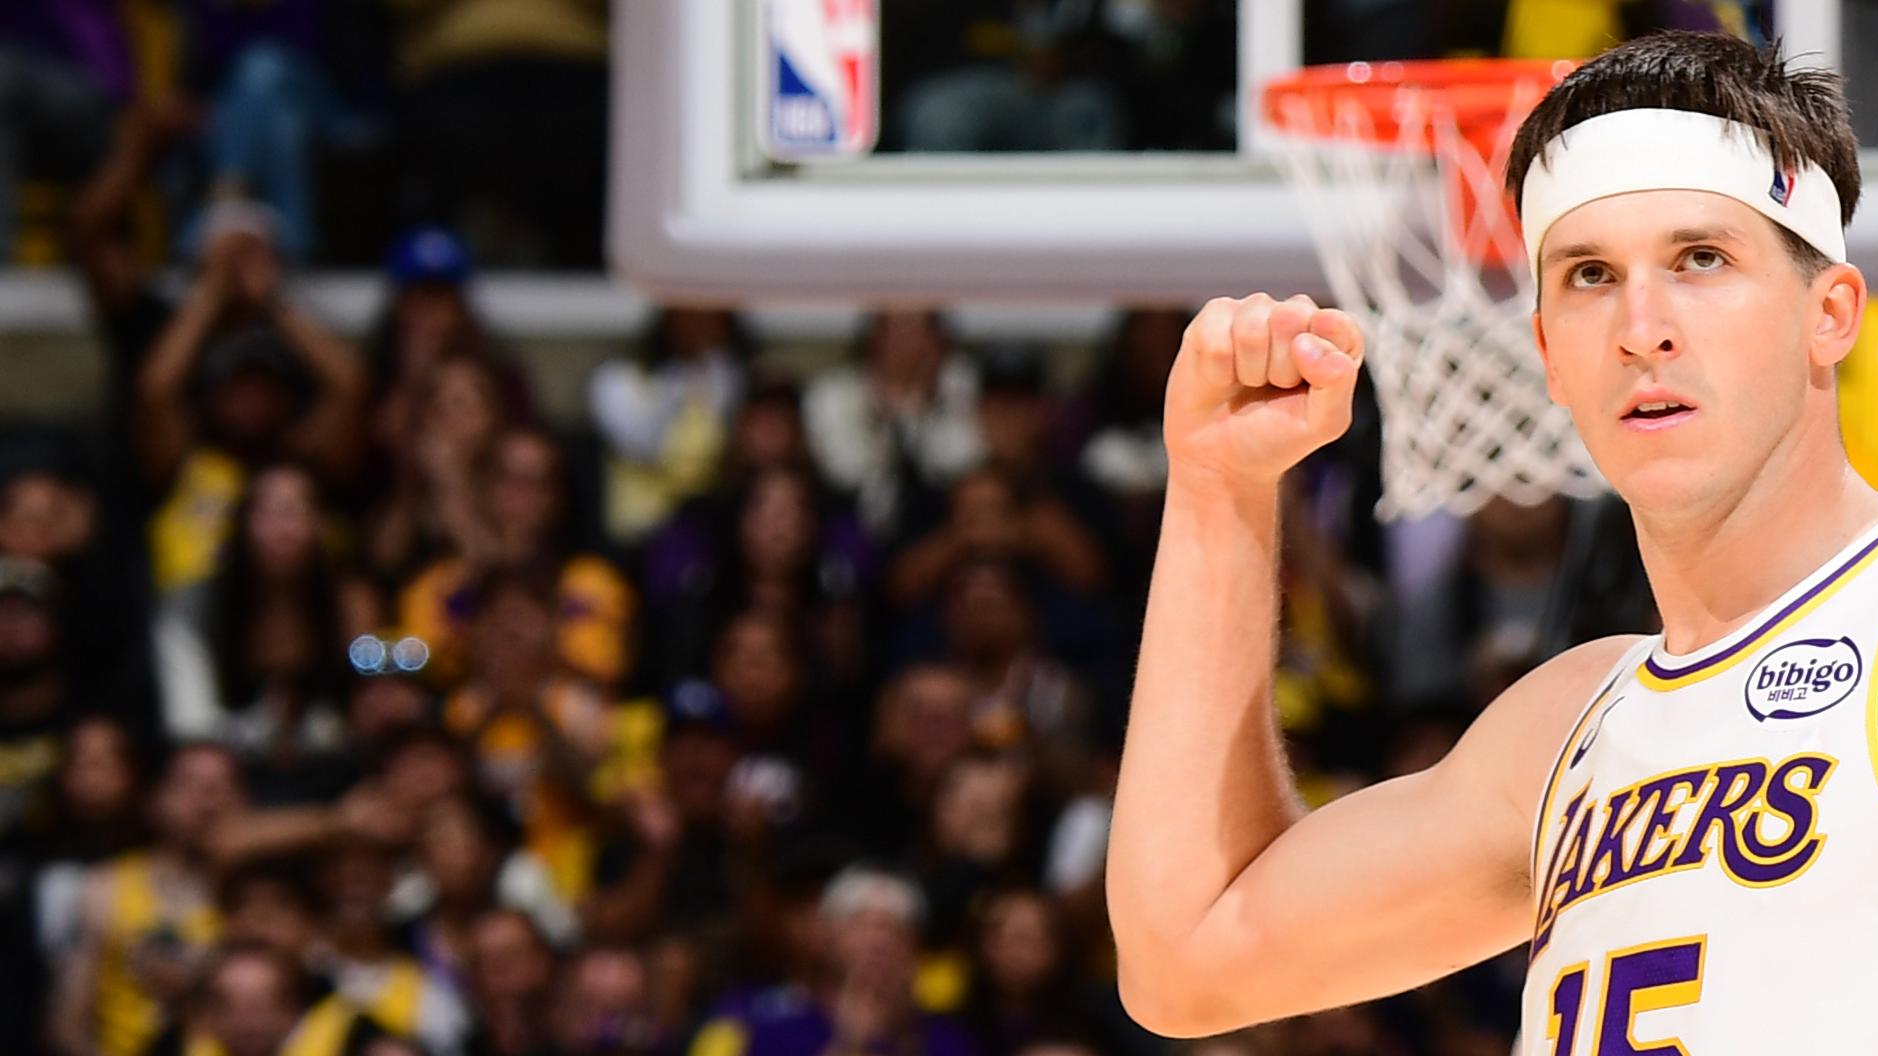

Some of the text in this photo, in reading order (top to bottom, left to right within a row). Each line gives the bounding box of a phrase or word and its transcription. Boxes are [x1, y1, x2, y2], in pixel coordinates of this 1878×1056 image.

[1756, 658, 1854, 693] bibigo
[1767, 686, 1808, 703] 비비고
[1529, 752, 1839, 965] LAKERS
